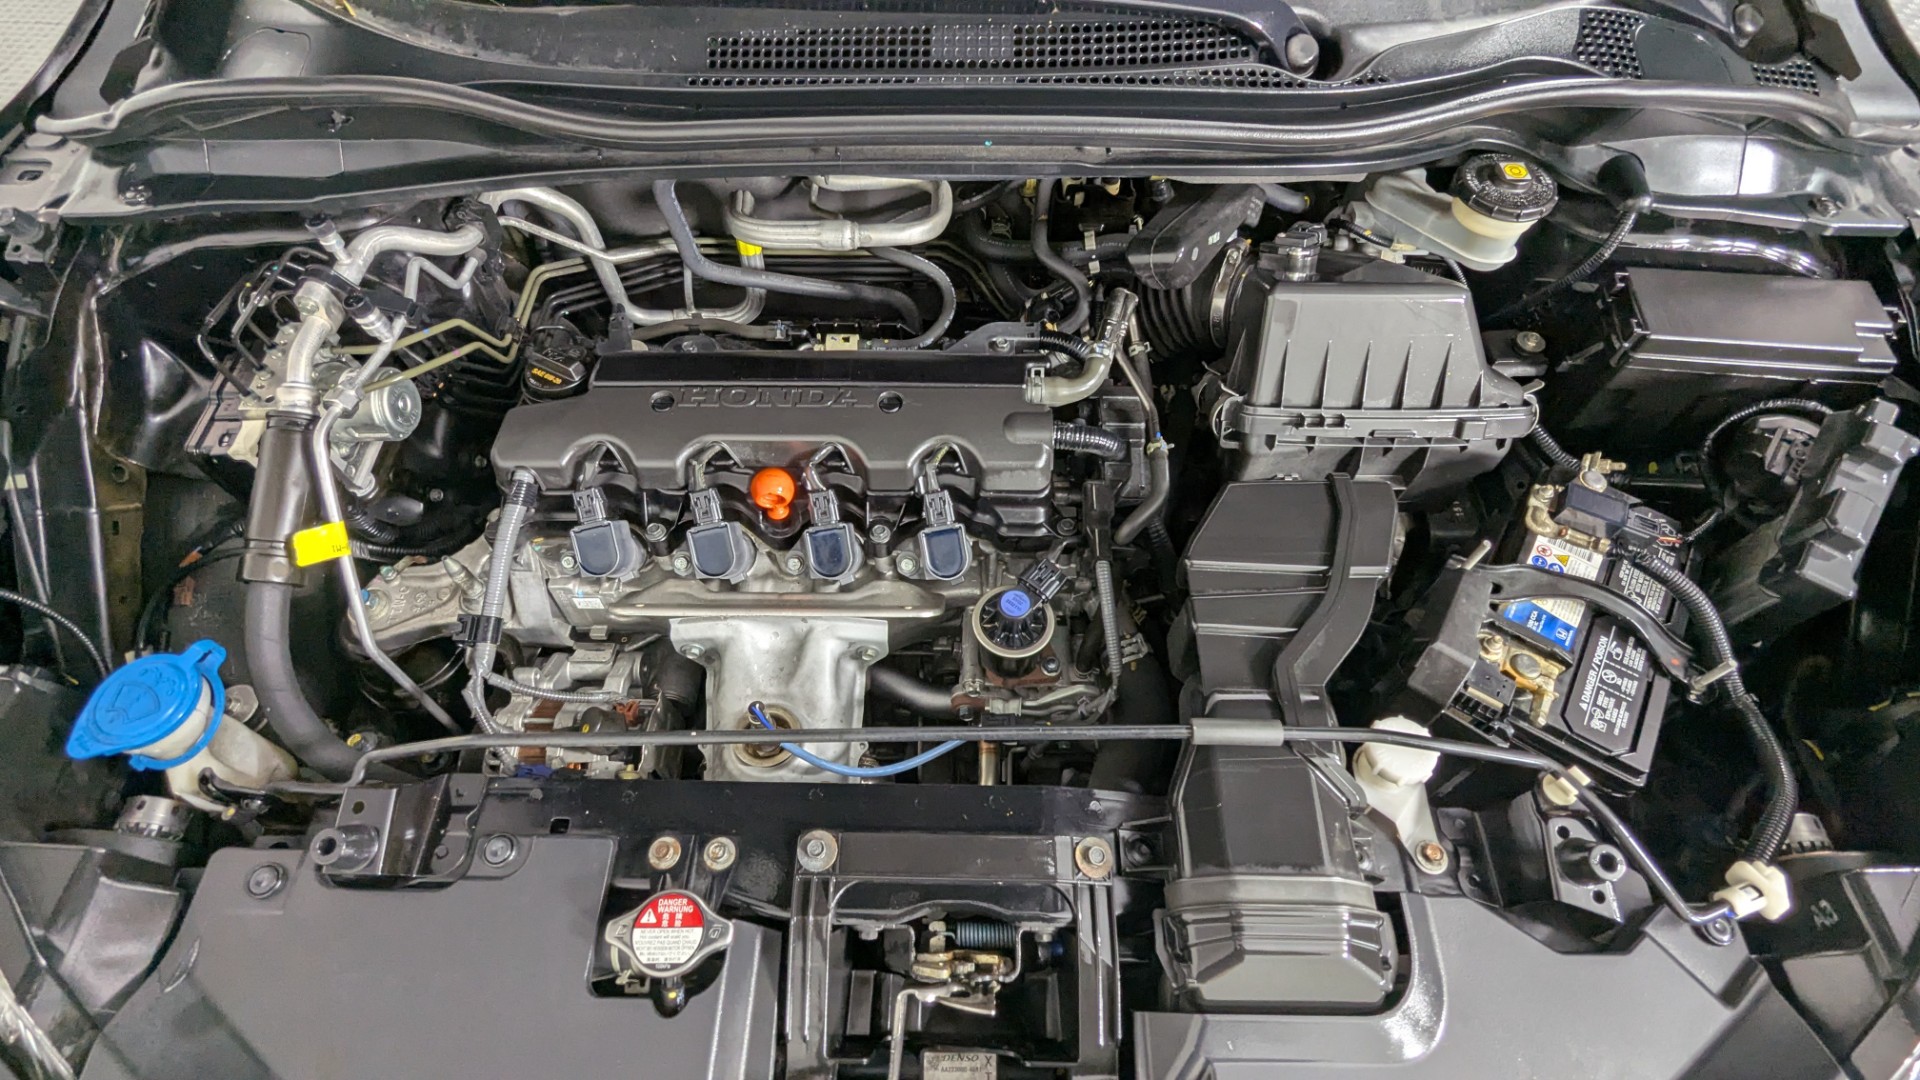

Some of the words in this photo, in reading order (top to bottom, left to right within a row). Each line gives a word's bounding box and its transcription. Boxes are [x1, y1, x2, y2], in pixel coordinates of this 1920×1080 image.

[677, 386, 875, 408] HONDA
[1581, 669, 1596, 703] DANGER
[1592, 635, 1609, 665] POISON
[658, 898, 688, 906] DANGER
[657, 905, 694, 913] WARNUNG
[942, 1053, 980, 1062] DENSO
